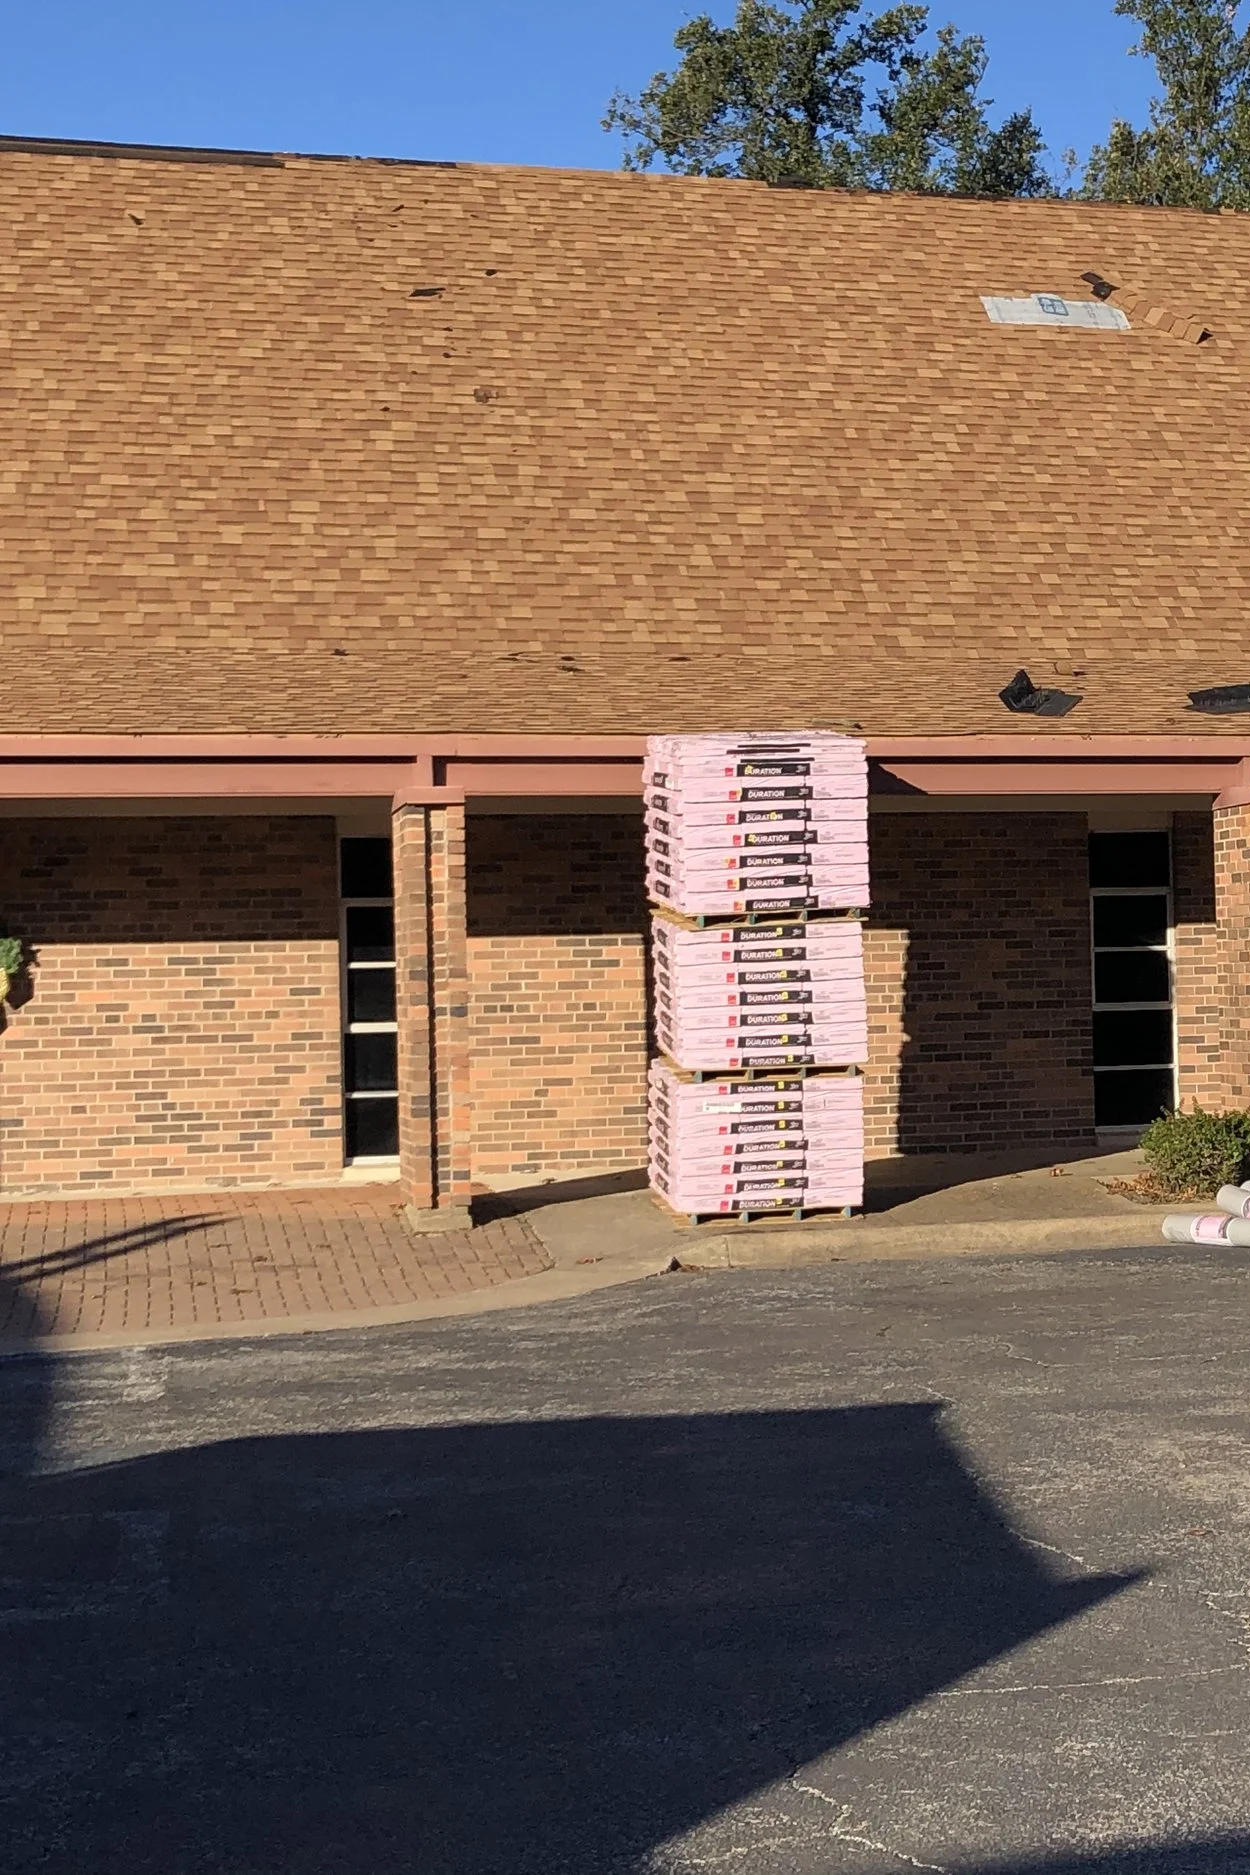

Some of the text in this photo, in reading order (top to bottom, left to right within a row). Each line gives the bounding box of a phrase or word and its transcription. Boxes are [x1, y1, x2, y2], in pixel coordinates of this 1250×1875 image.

[744, 767, 782, 775] URATION
[748, 790, 785, 798] DURATION
[746, 813, 783, 822] DURATN
[747, 858, 783, 866] DURATION
[747, 878, 784, 887] DURATION
[753, 900, 790, 909] DURATION
[741, 931, 778, 940] DURATION
[746, 1038, 782, 1046] DURATION
[738, 1085, 775, 1093] DURATION
[740, 1105, 775, 1113] URATION
